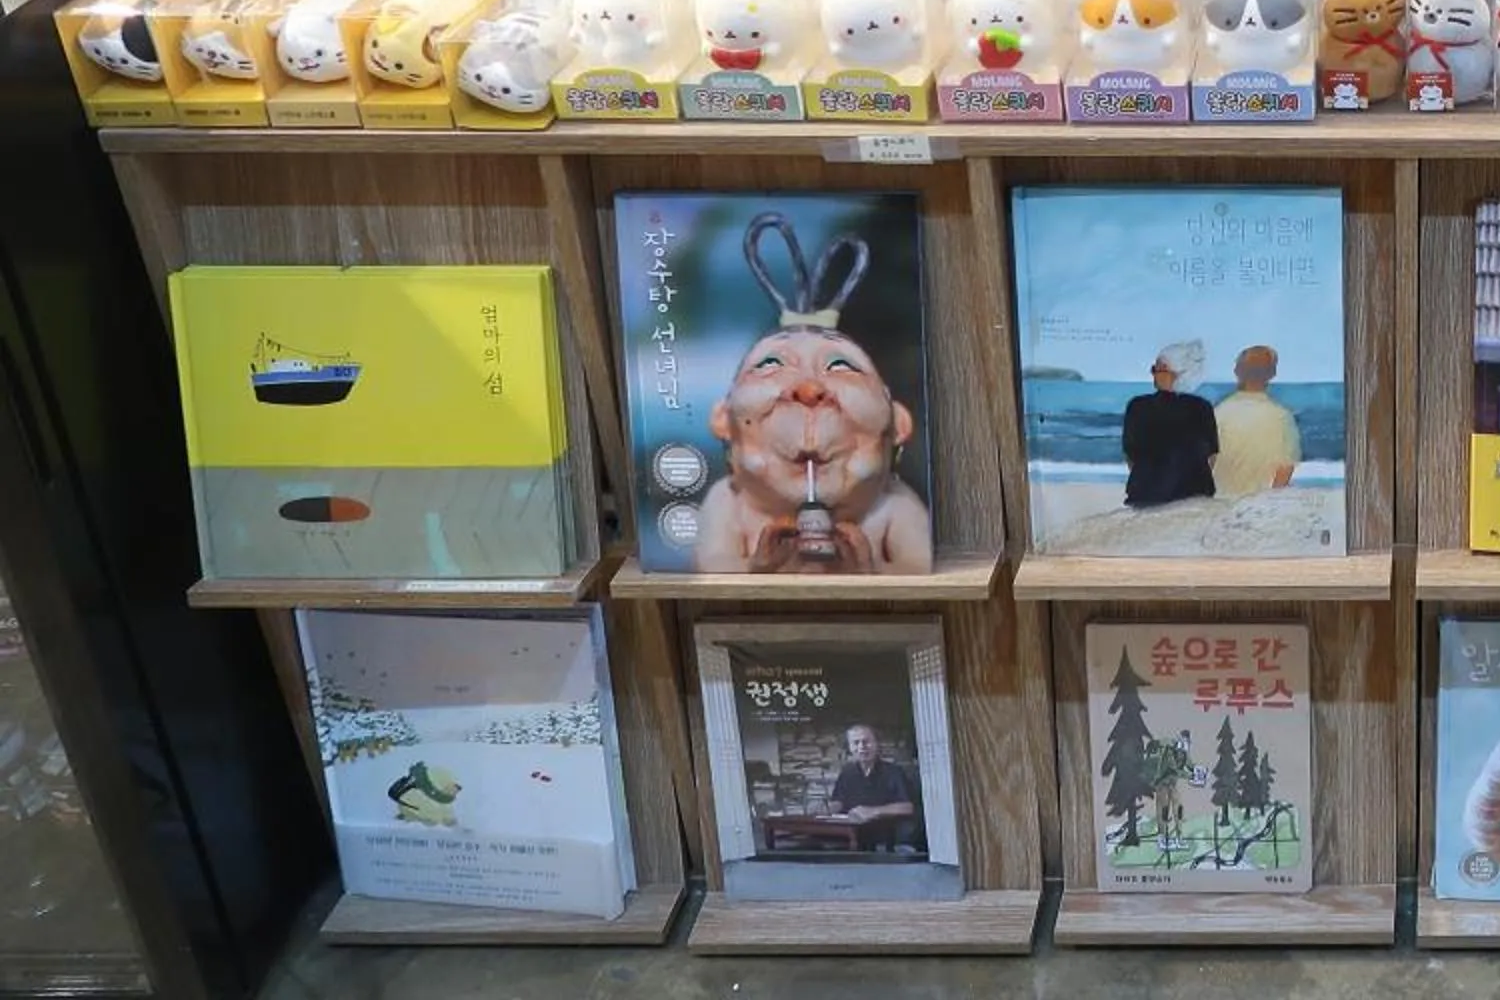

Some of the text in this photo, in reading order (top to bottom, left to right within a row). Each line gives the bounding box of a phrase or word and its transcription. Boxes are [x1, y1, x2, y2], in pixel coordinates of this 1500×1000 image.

[971, 75, 1024, 88] MOLANG
[1100, 77, 1151, 90] MOLANG
[1226, 76, 1279, 89] MOLANG
[1185, 212, 1314, 248] 당신의 마음에
[642, 227, 681, 411] 장수탕 선녀님
[1151, 636, 1289, 677] 숲으로 간
[744, 681, 829, 708] 권정생
